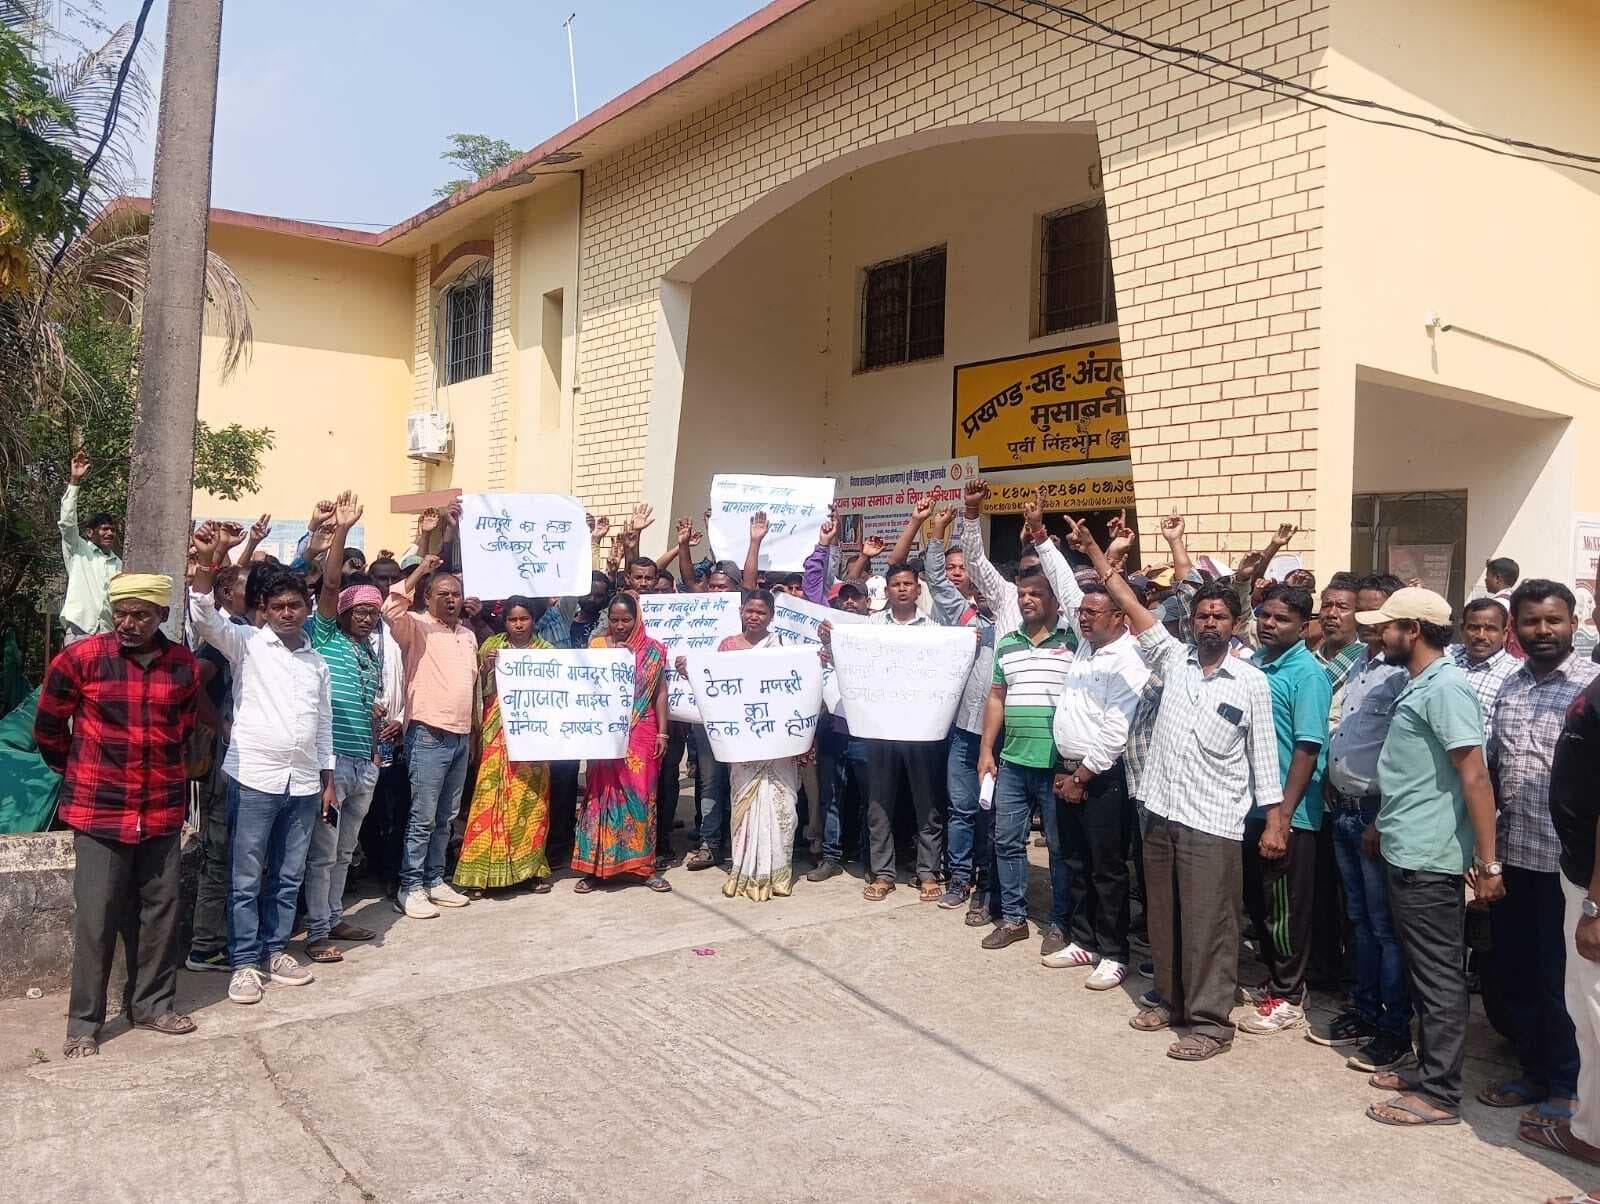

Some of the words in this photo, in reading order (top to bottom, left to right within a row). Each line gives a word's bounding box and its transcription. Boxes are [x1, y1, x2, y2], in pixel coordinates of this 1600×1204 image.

[1030, 387, 1127, 432] मुसाबनी
[1007, 436, 1035, 461] पूर्वी
[1043, 432, 1101, 455] सिंहभूम
[867, 493, 893, 508] समाज
[895, 489, 905, 505] के
[519, 521, 536, 534] का
[542, 534, 567, 554] देना
[642, 600, 666, 613] ठेका
[703, 668, 744, 697] ठेका
[744, 702, 768, 719] का
[706, 720, 739, 737] हक
[744, 715, 776, 738] देना
[785, 709, 817, 737] होगा
